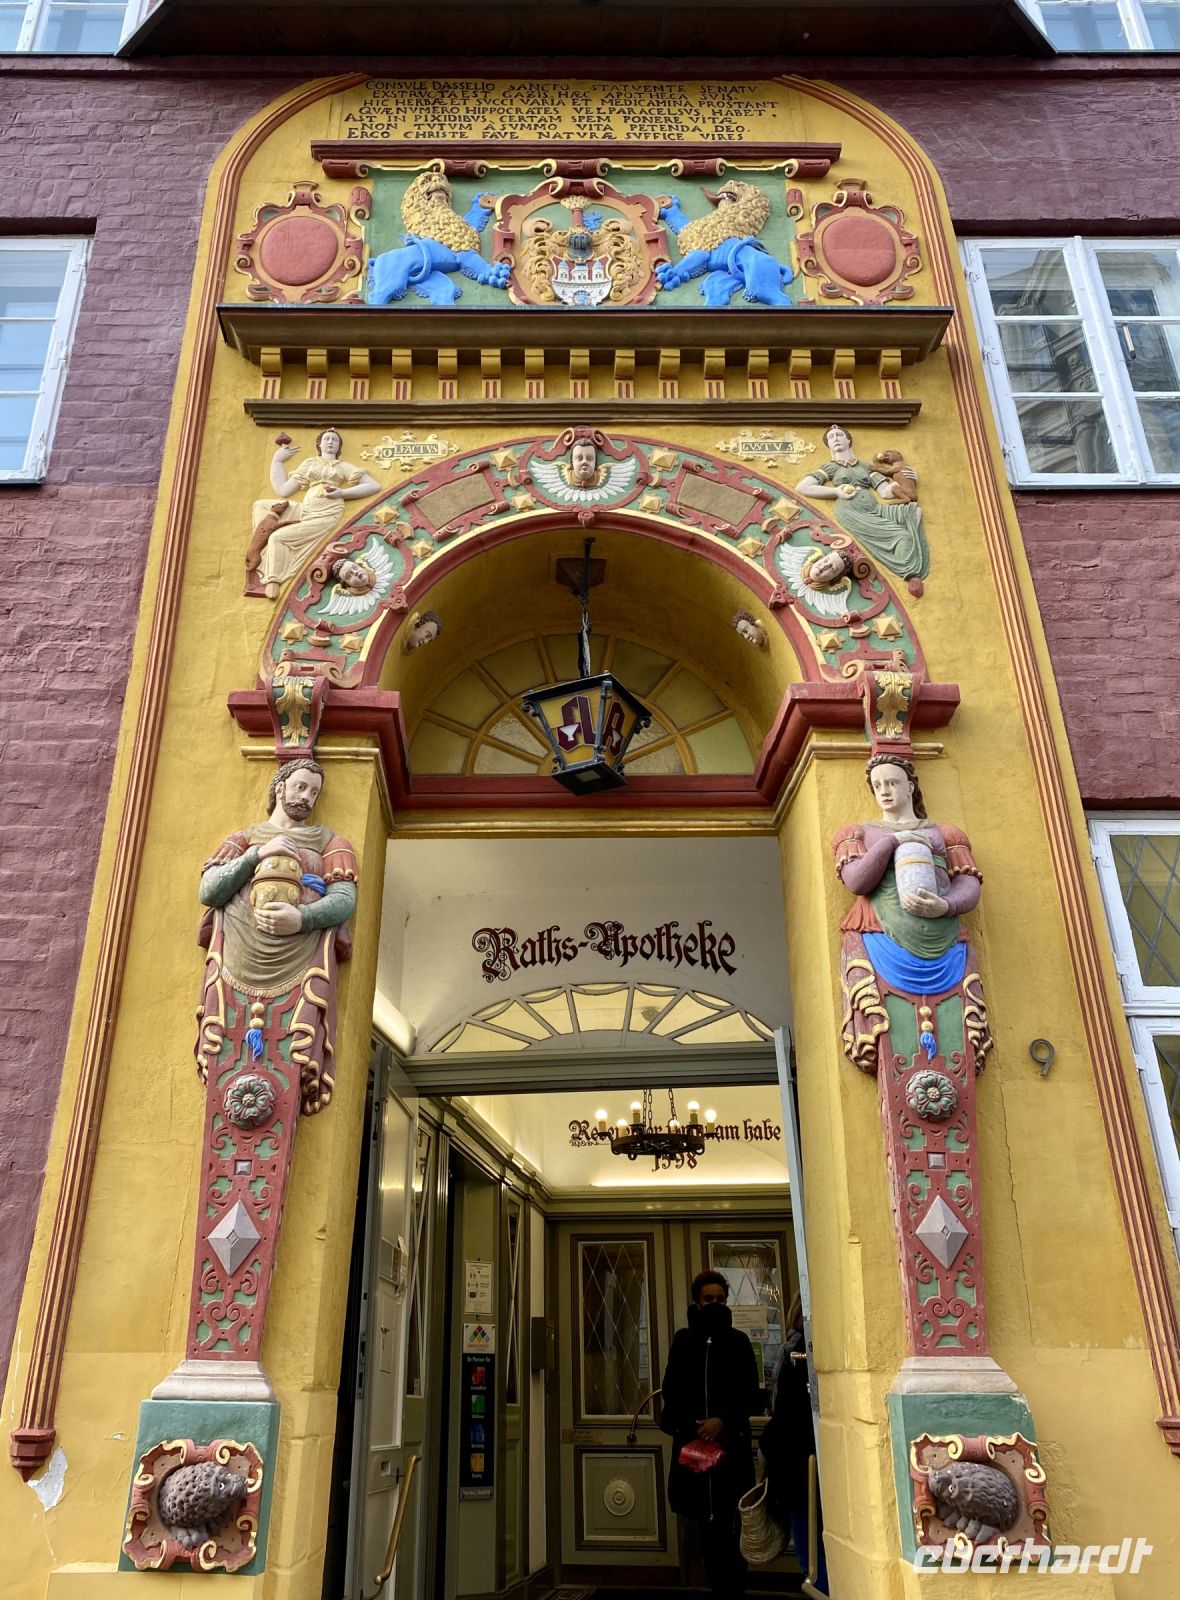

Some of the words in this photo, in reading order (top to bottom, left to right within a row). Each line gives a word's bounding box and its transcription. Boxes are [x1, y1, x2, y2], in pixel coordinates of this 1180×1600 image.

[365, 81, 427, 90] CONSVLE
[591, 84, 686, 93] STATVENTE
[700, 85, 758, 94] SENATV
[475, 98, 514, 106] SVCCI
[519, 98, 566, 106] VARIA
[600, 99, 694, 108] MEDICAMINA
[698, 100, 779, 109] PROSTANT
[465, 107, 560, 115] HIPPOCRATES
[344, 113, 377, 122] AST
[499, 115, 562, 123] CERTAM
[571, 115, 611, 123] SPEM
[623, 116, 682, 124] PONERE
[413, 123, 472, 131] TVTVM
[630, 124, 703, 132] PETENDA
[403, 131, 469, 139] CHRISTE
[482, 131, 519, 139] FAVE
[624, 132, 685, 140] SVFFICE
[700, 133, 744, 141] VIRES
[472, 920, 737, 983] Raths-Apotheke
[1029, 1038, 1055, 1076] 9
